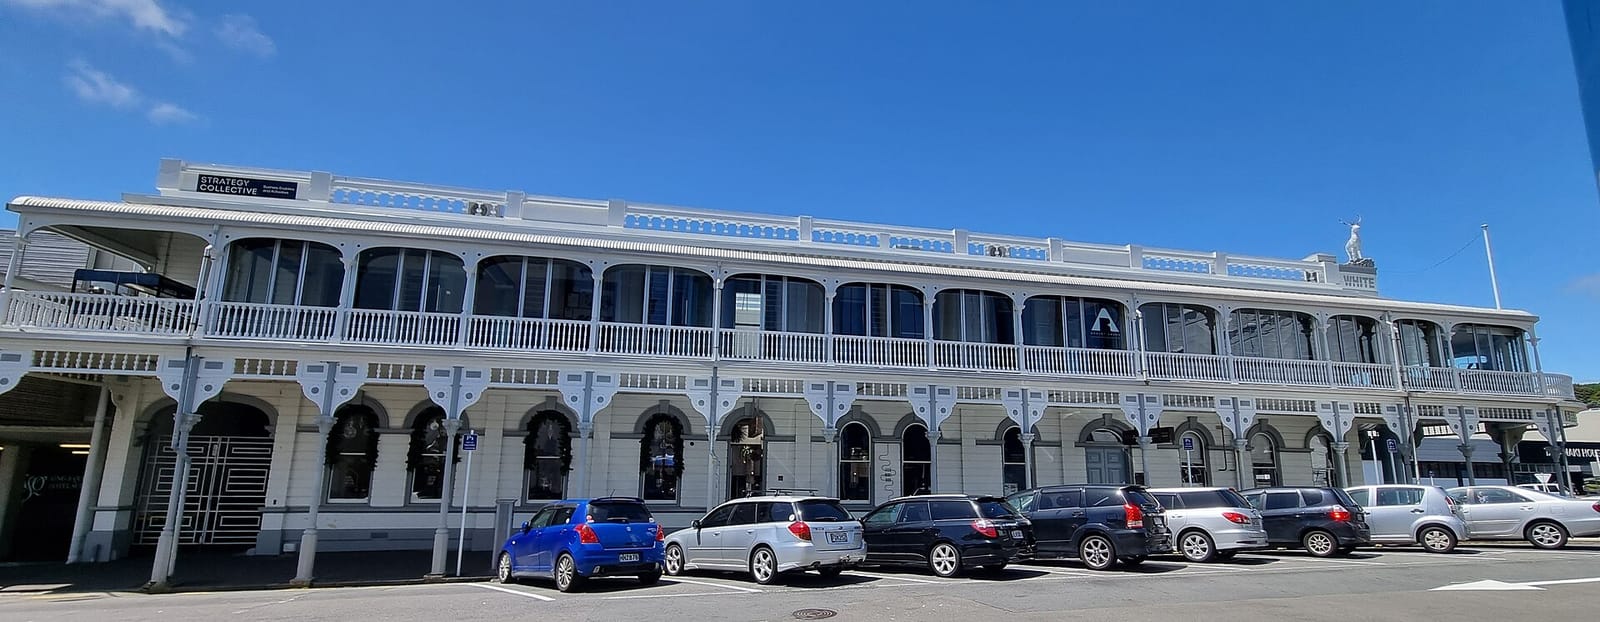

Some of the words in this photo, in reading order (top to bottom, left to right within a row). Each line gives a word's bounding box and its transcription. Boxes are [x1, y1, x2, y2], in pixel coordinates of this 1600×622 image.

[201, 176, 250, 187] STRATEGY
[200, 184, 258, 195] COLLECTIVE
[1343, 275, 1375, 288] WHITE
